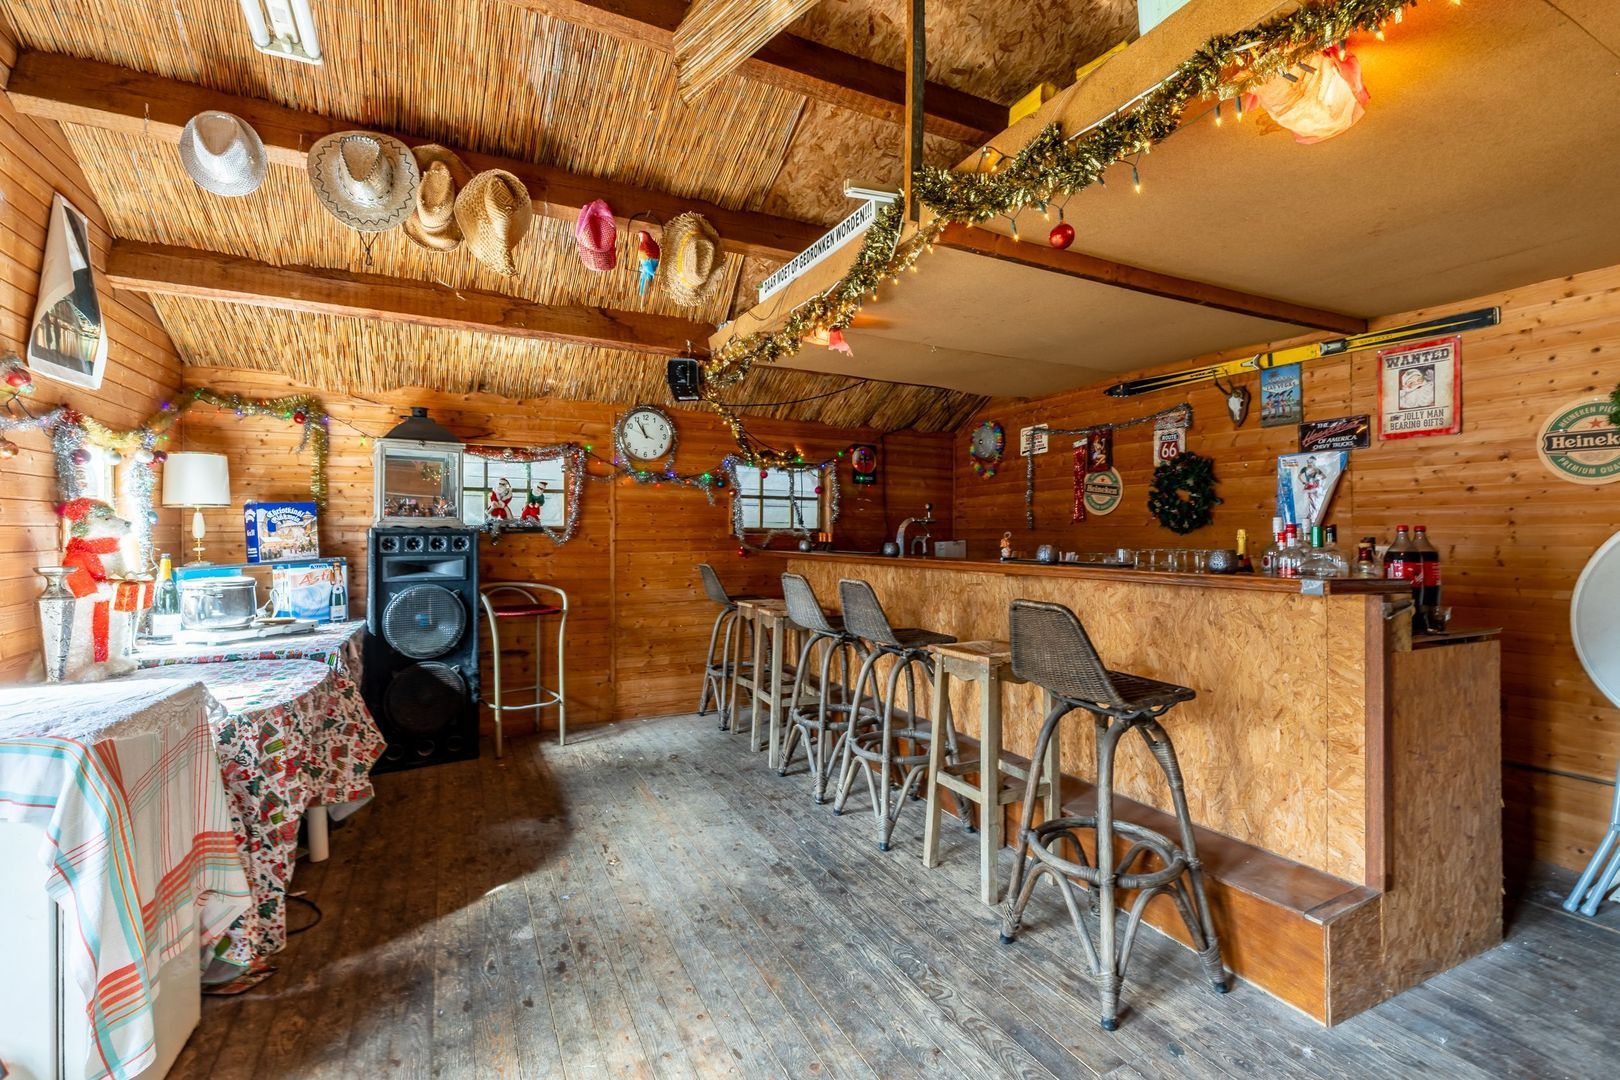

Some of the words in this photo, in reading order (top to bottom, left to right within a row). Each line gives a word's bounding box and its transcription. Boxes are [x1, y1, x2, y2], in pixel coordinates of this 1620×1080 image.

[764, 274, 776, 294] DAAR
[776, 264, 790, 285] MOET
[790, 257, 799, 275] OP
[800, 234, 834, 269] GEDRONKEN
[836, 202, 872, 243] WORDEN!!!
[1385, 347, 1450, 369] WANTED
[1402, 410, 1425, 421] JOLLY
[1427, 408, 1445, 419] MAN
[1558, 405, 1597, 428] HEINEKEN
[1316, 421, 1329, 430] THE
[1390, 420, 1421, 431] BEARING
[1423, 418, 1444, 429] GIFTS
[1326, 434, 1358, 445] AMERICA
[1161, 441, 1177, 459] 66
[1558, 456, 1596, 475] PREMIUM
